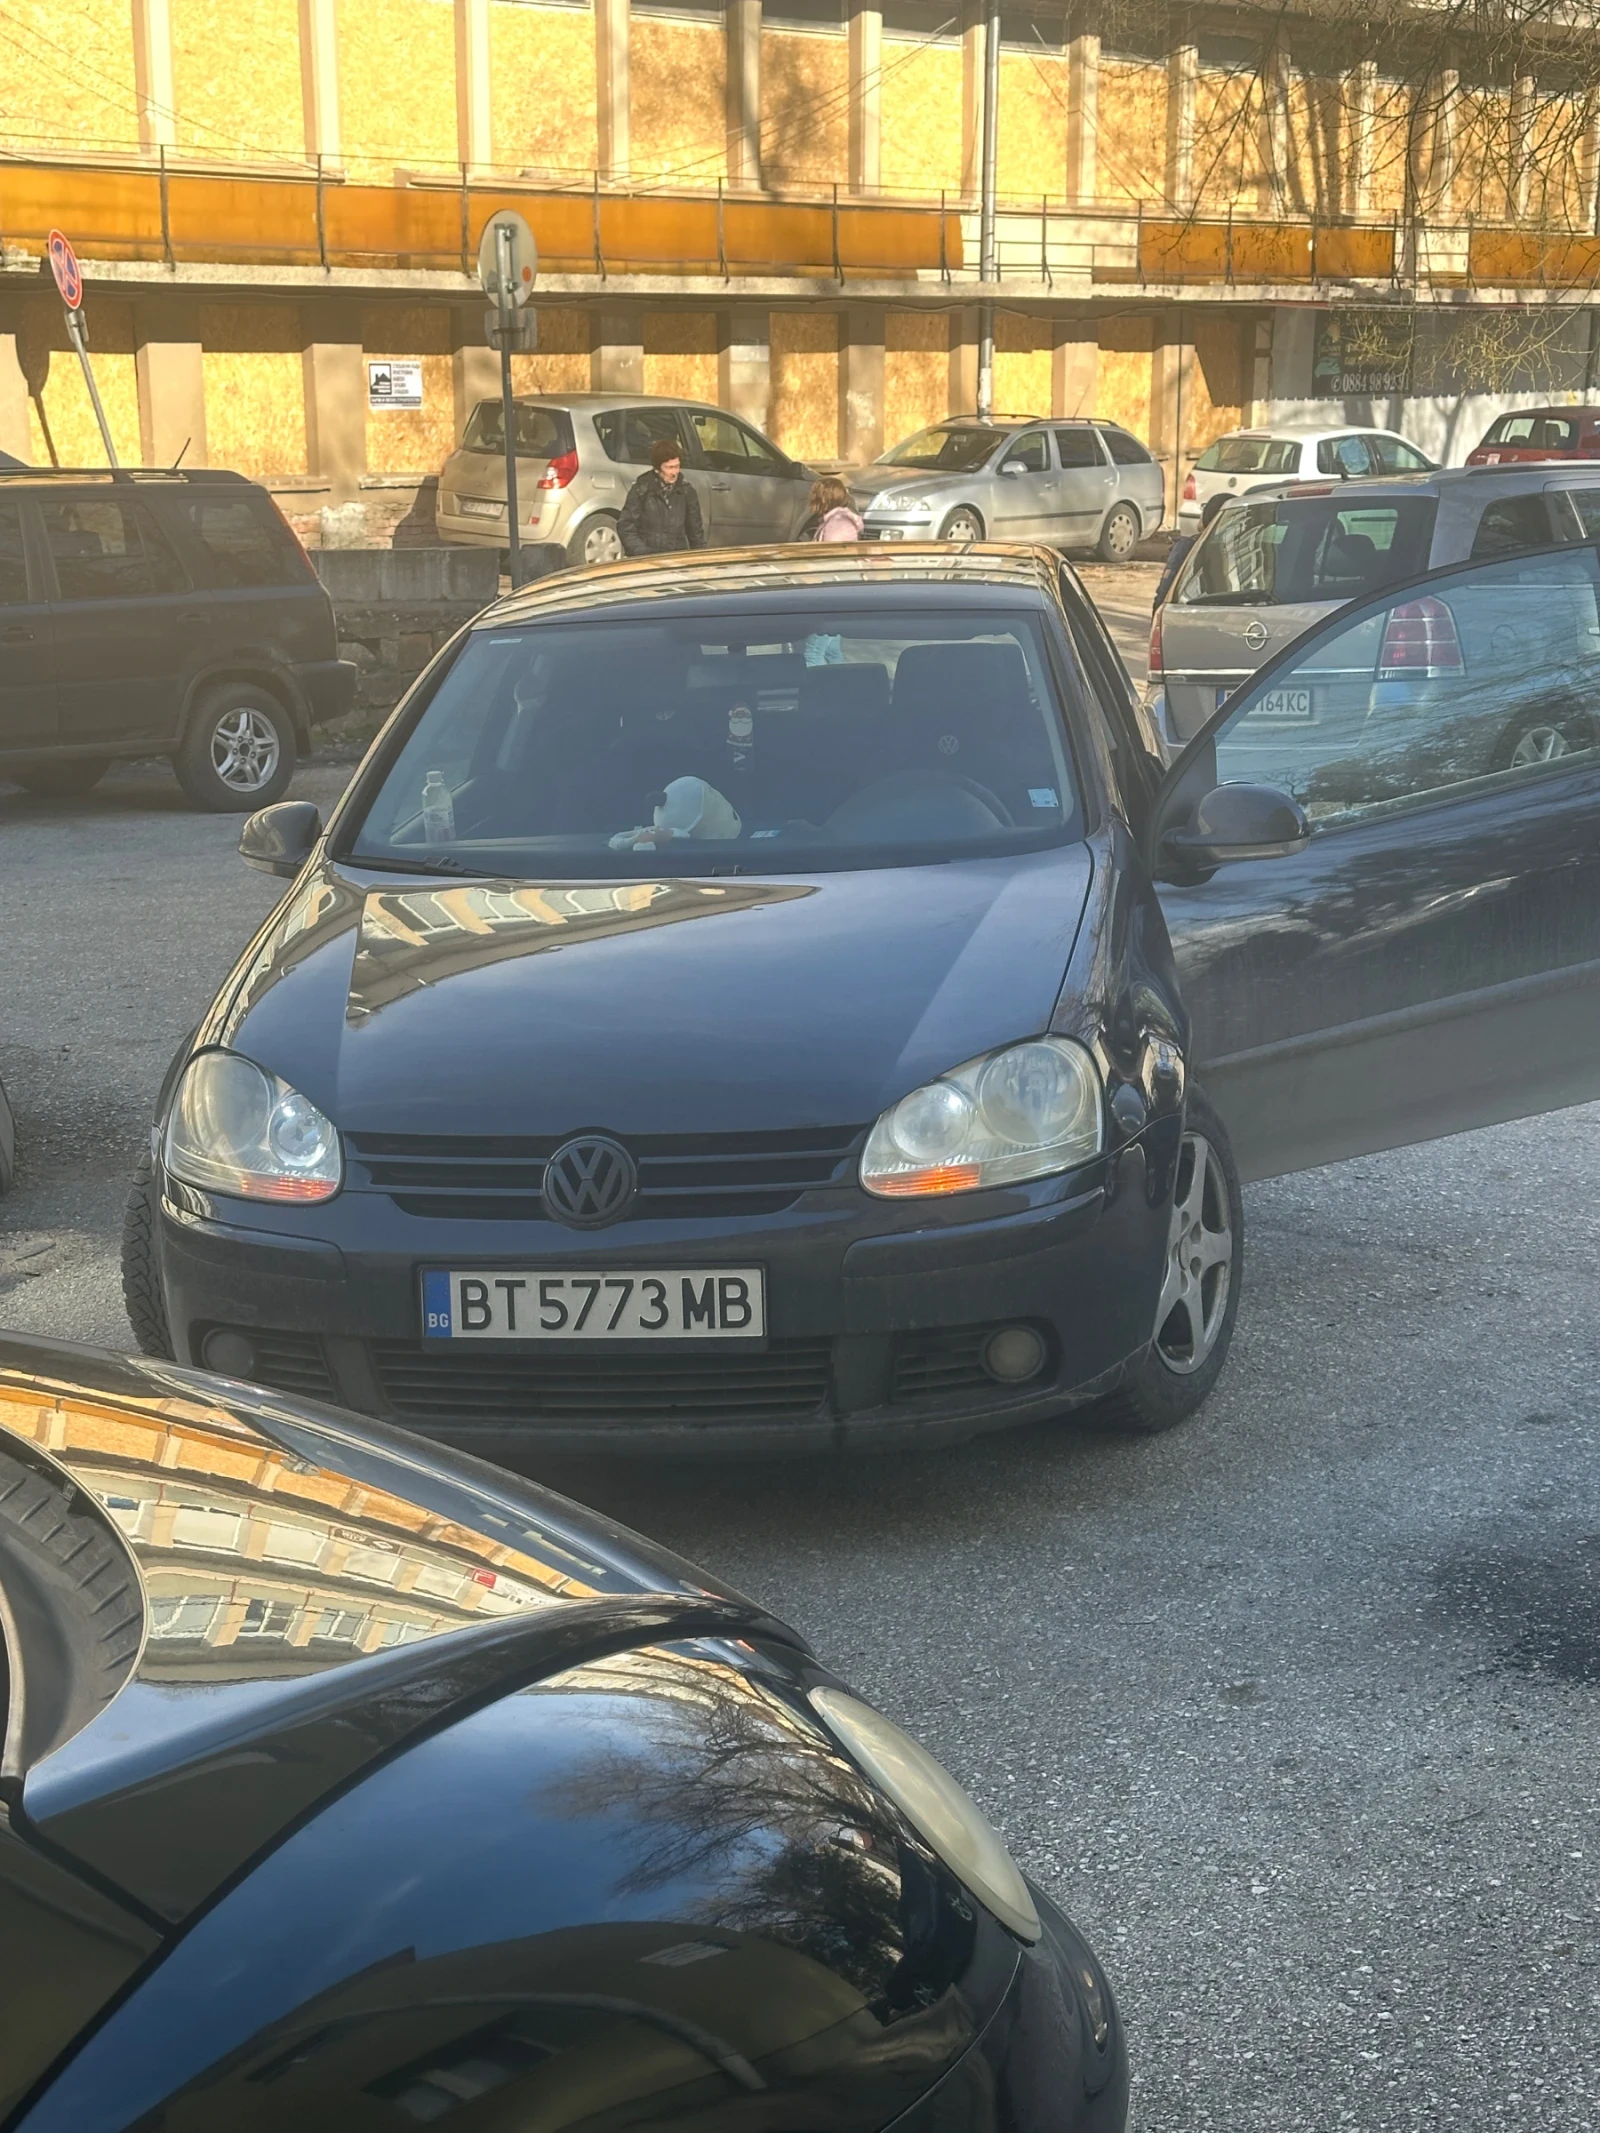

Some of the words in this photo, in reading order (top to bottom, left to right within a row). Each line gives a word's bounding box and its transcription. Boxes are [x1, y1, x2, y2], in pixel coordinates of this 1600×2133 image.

[1343, 374, 1366, 392] 0884
[1369, 373, 1382, 391] 98
[1286, 693, 1308, 712] KC
[459, 1278, 526, 1332] BT
[538, 1278, 670, 1331] 5773
[681, 1276, 753, 1330] MB
[428, 1312, 449, 1328] BG
